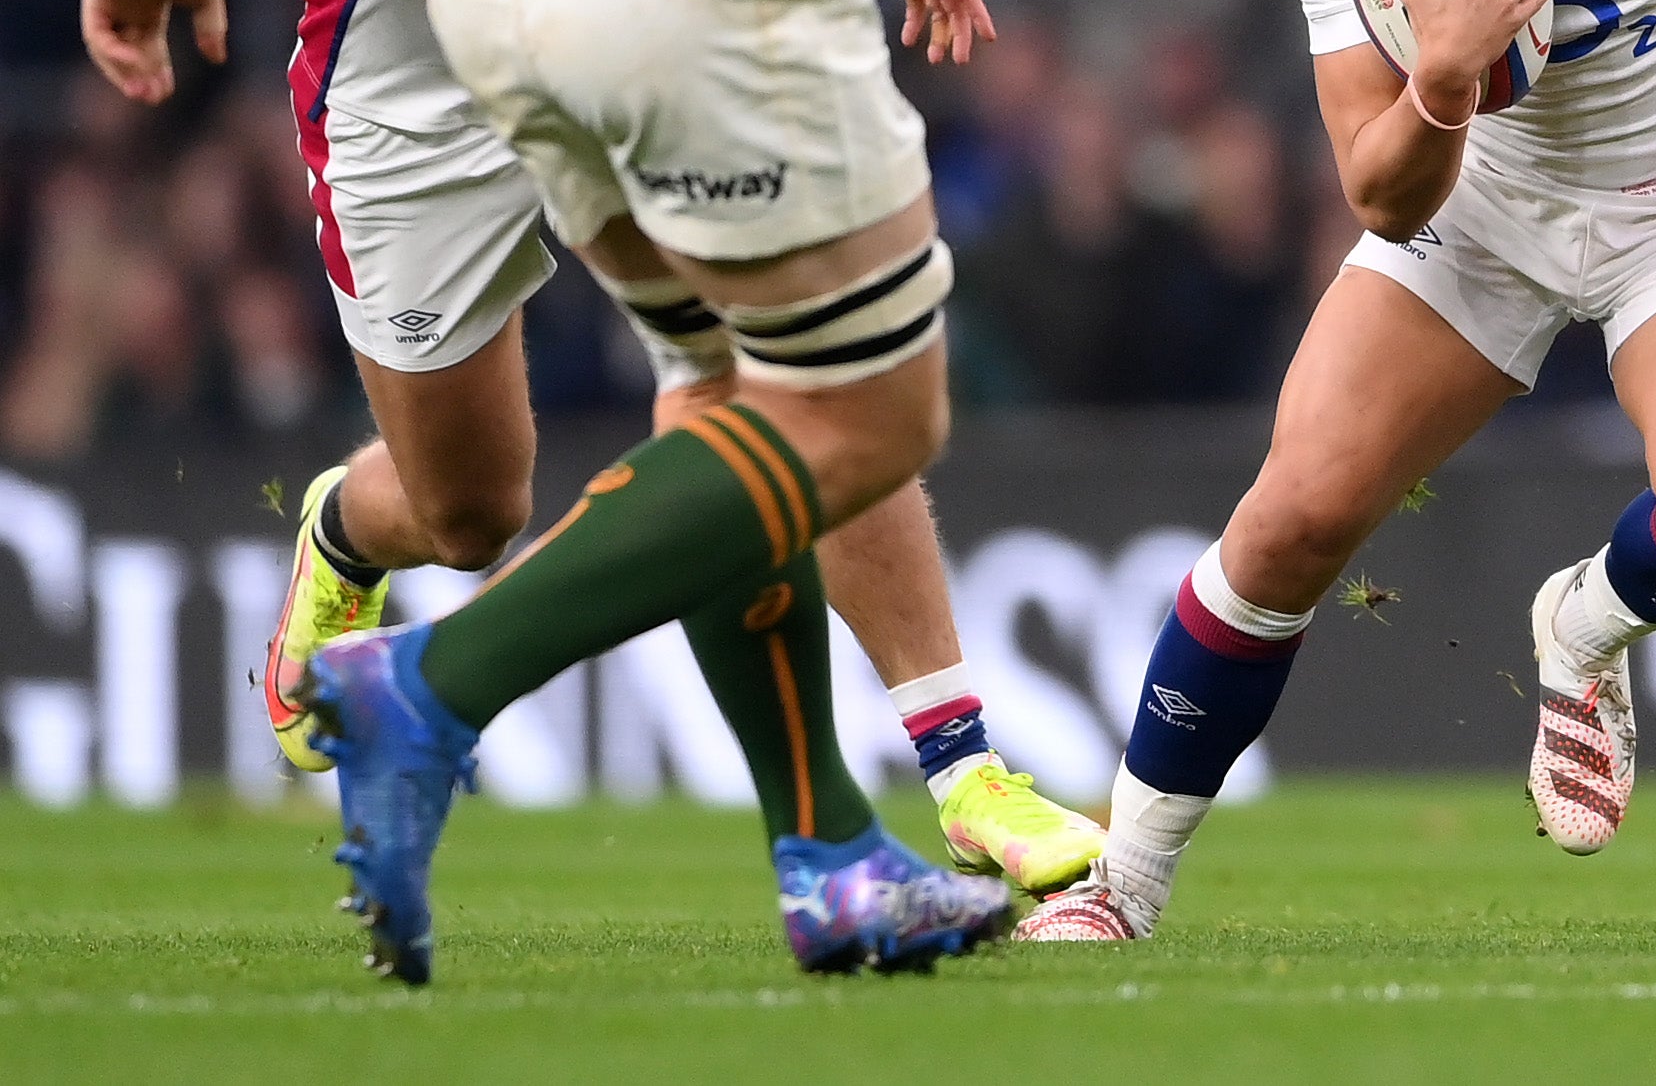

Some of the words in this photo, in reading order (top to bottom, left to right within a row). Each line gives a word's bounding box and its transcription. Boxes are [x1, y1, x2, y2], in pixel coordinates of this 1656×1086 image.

[1393, 242, 1427, 261] bro
[395, 333, 440, 344] umbro
[1147, 701, 1196, 731] umbro
